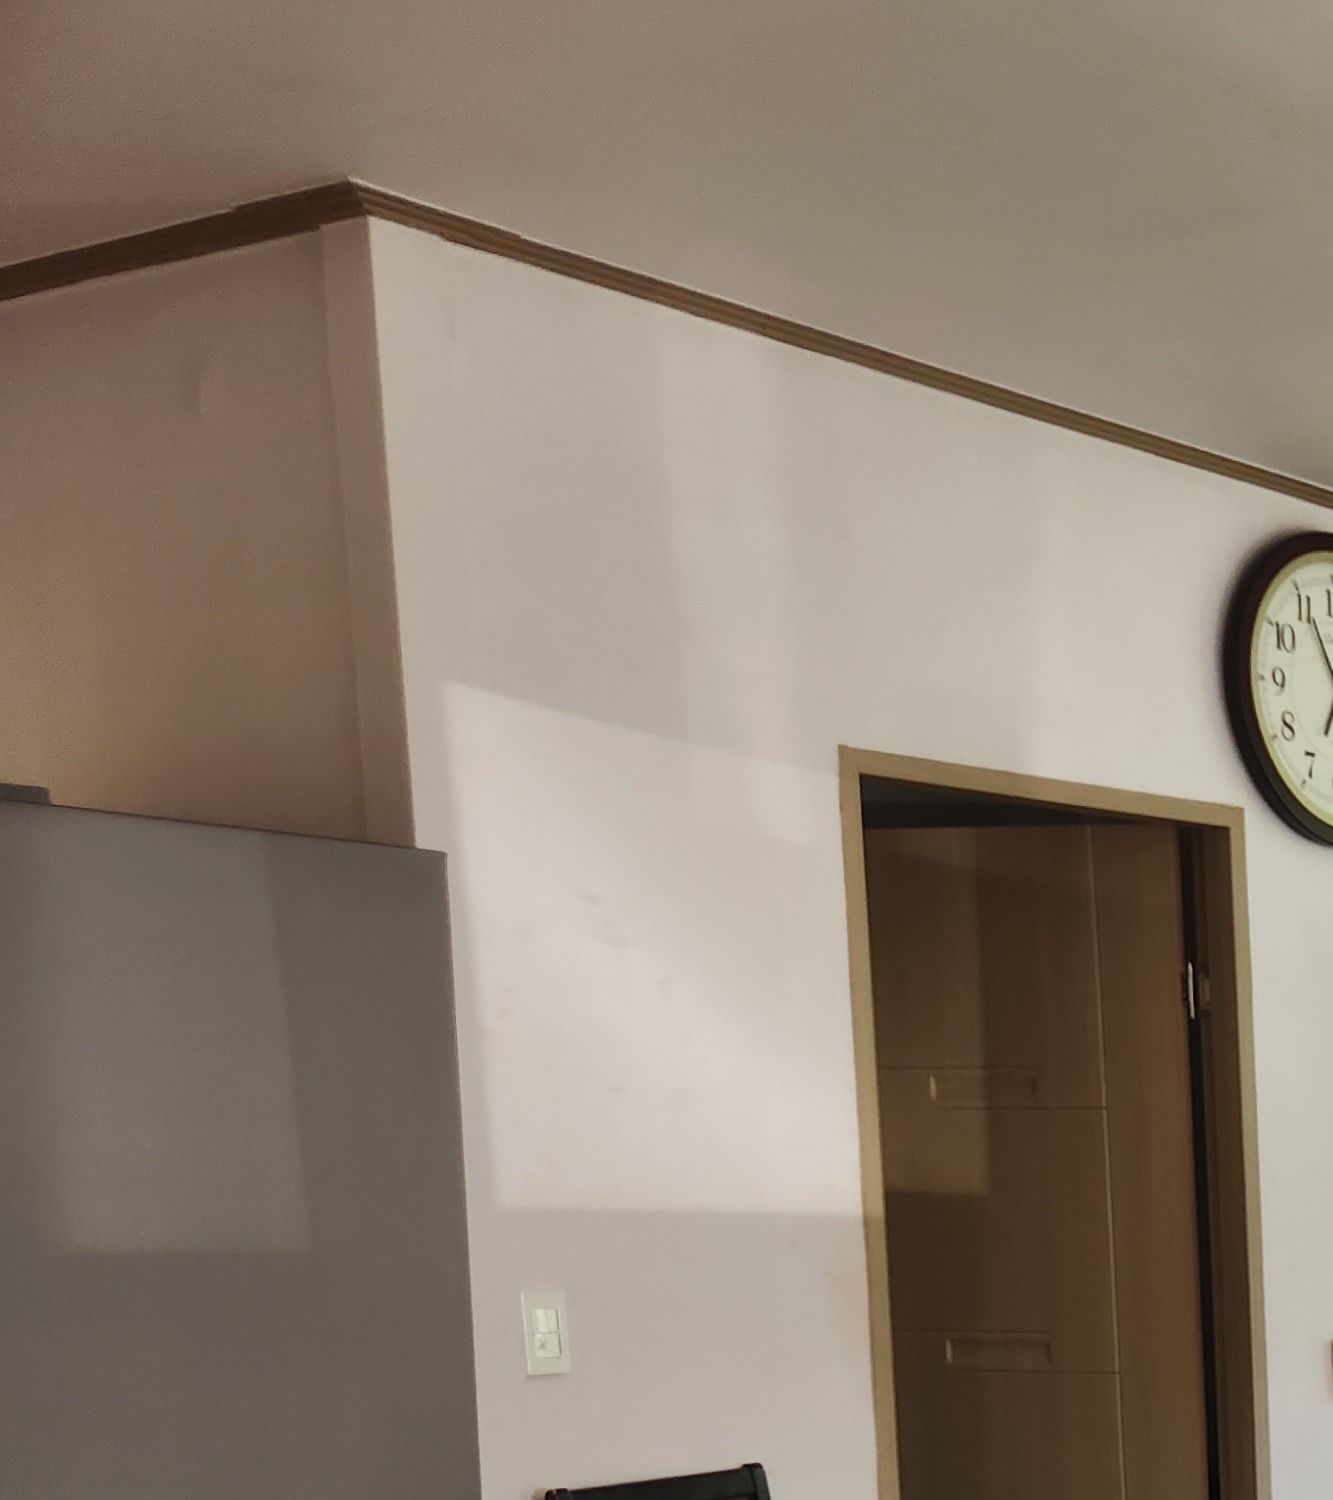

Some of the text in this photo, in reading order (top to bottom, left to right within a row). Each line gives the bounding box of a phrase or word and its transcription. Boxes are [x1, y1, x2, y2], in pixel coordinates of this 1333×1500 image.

[1297, 593, 1312, 624] 11
[1274, 621, 1296, 653] 10
[1272, 667, 1286, 696] 9
[1281, 710, 1295, 741] 8
[1304, 751, 1315, 779] 7
